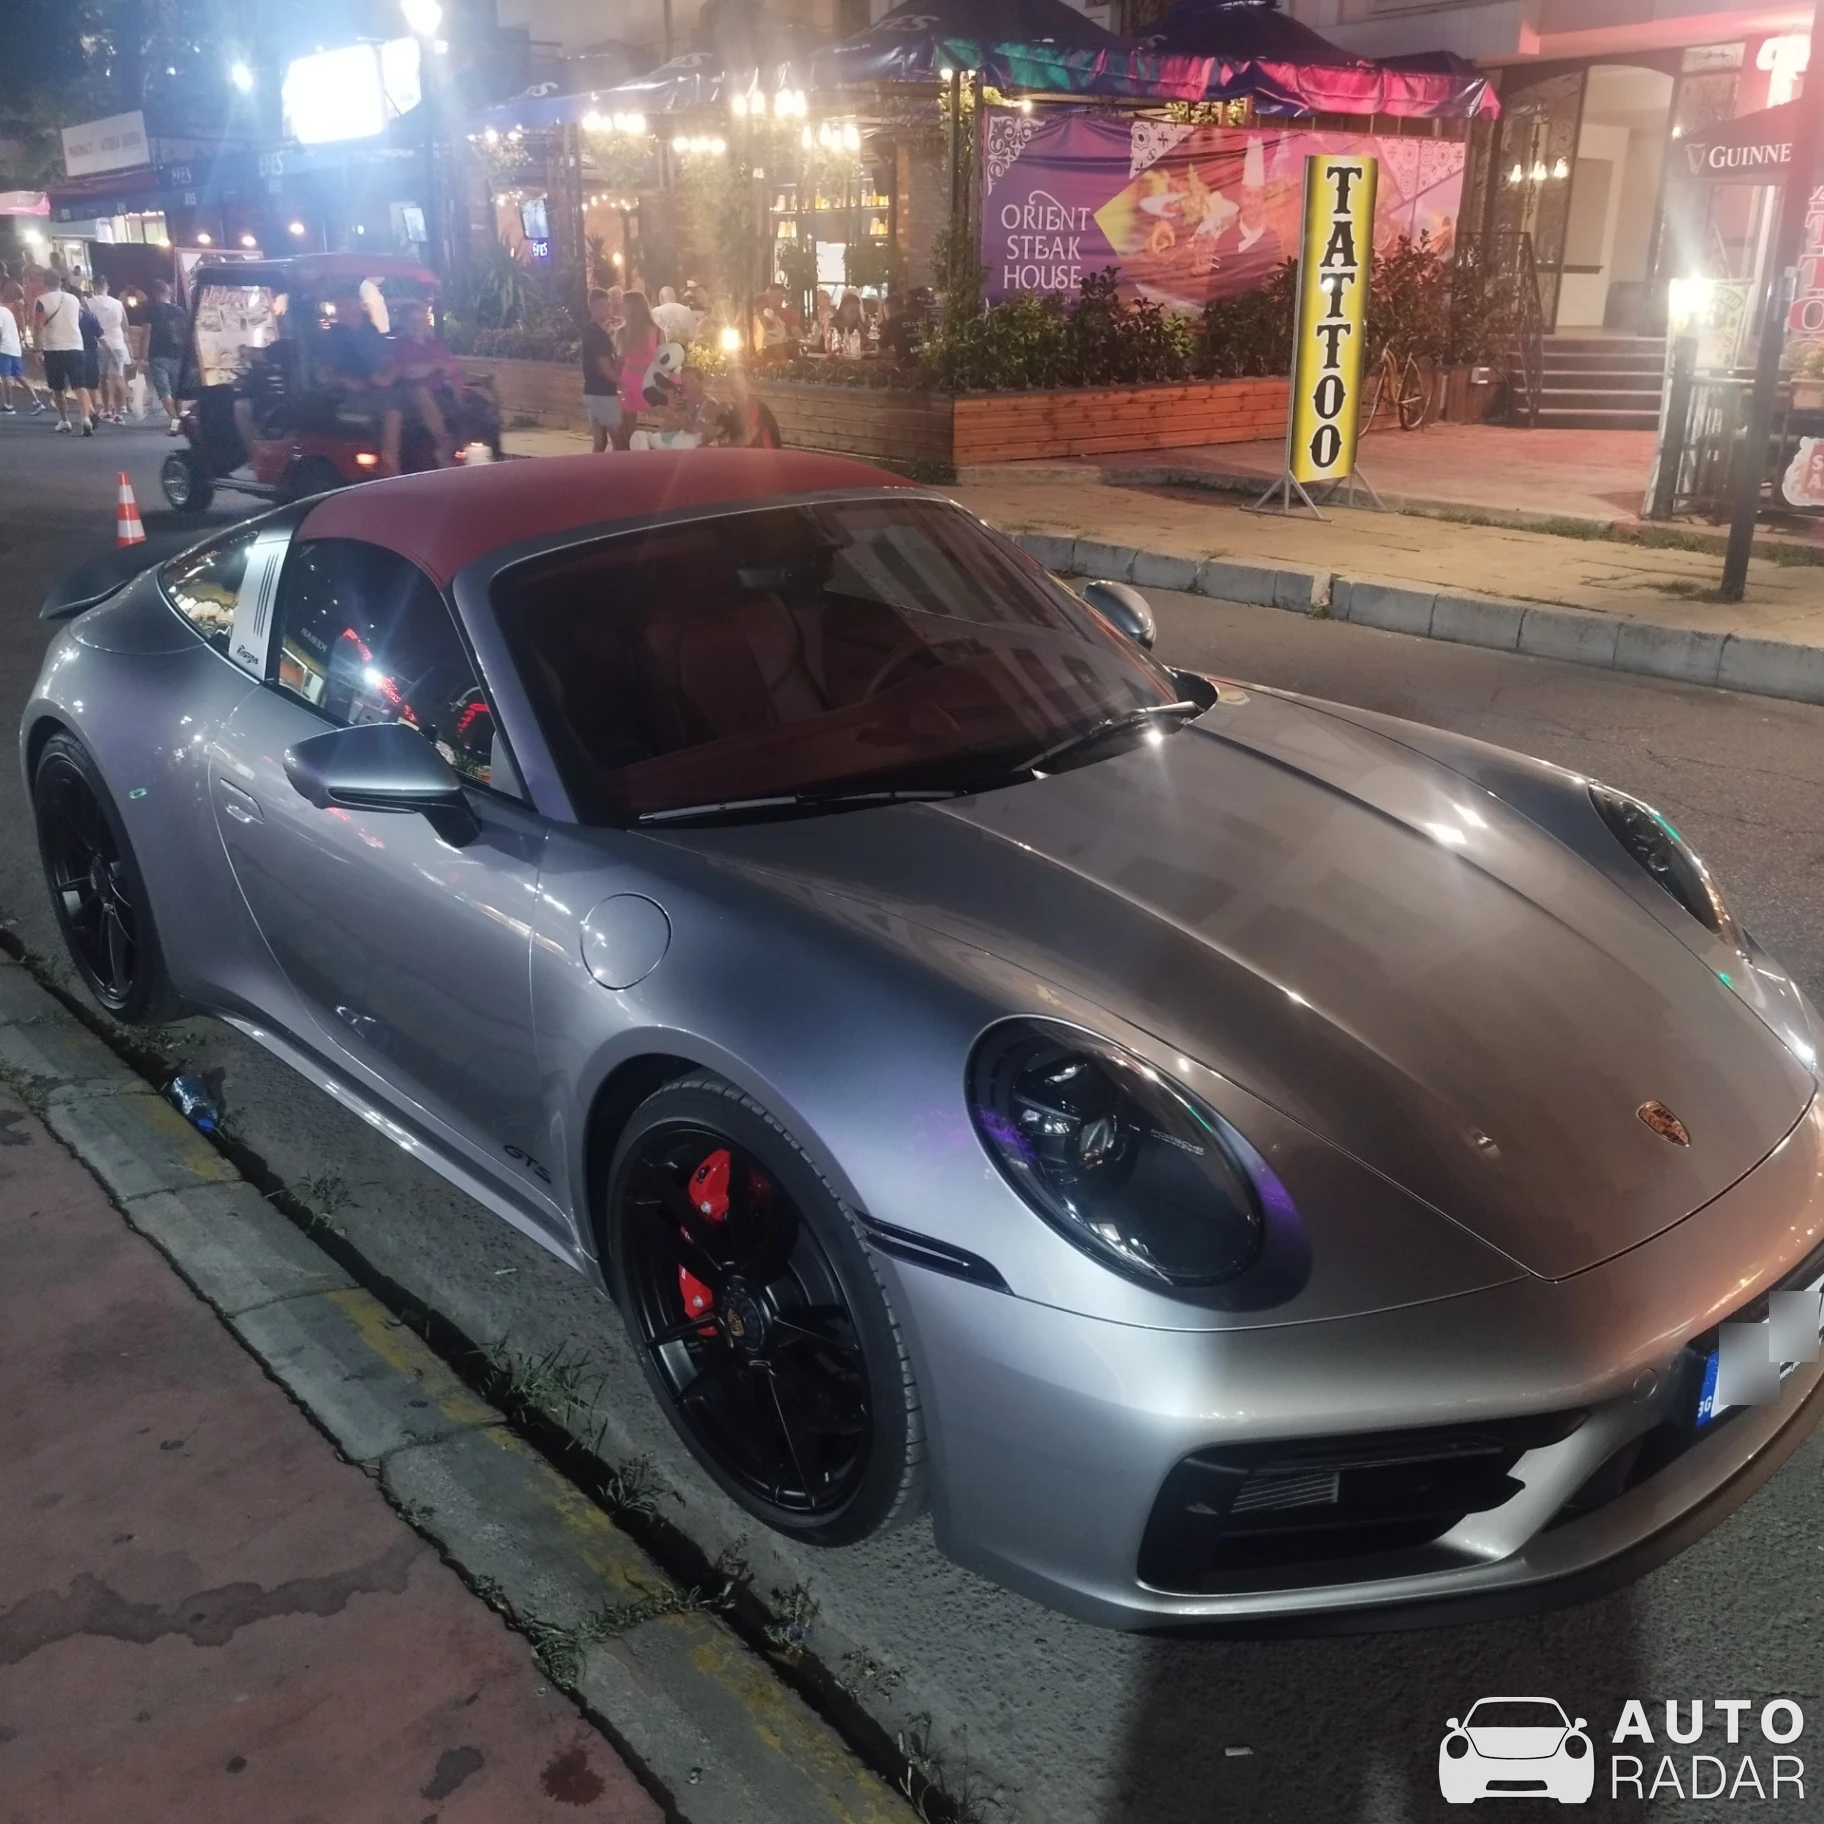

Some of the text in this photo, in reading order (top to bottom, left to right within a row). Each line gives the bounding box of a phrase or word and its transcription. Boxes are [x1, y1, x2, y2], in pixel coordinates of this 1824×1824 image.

[1708, 142, 1793, 168] GUINNE
[1001, 190, 1091, 231] ORIENT
[1006, 235, 1082, 260] STEAK
[1003, 265, 1084, 289] HOUSE
[1309, 166, 1362, 468] TATTOO
[503, 1144, 552, 1184] GTS
